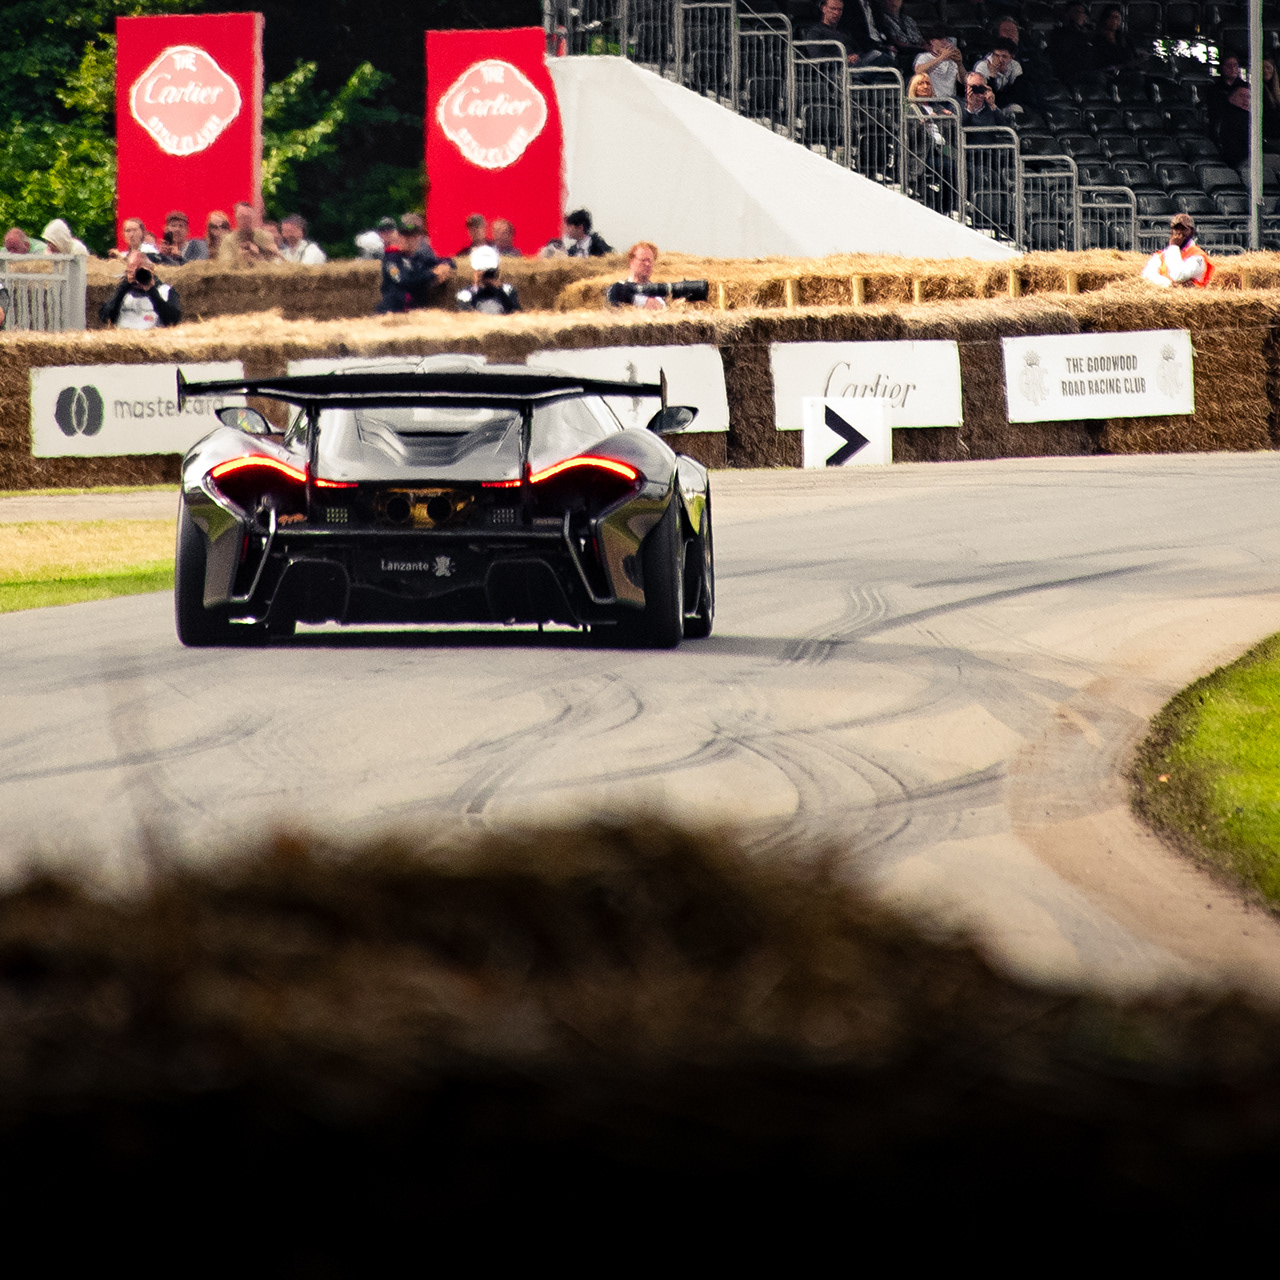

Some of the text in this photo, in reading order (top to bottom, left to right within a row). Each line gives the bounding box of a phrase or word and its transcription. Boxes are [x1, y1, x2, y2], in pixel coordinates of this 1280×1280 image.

[172, 53, 197, 72] THE
[144, 73, 224, 105] Cartier
[452, 87, 532, 117] Cartier
[1066, 355, 1138, 374] THE GOODWOOD
[824, 361, 916, 408] Cartier
[1061, 380, 1086, 397] ROAD
[1088, 379, 1121, 395] RACING
[1124, 377, 1146, 394] CLUB
[381, 559, 429, 571] Lanzante
